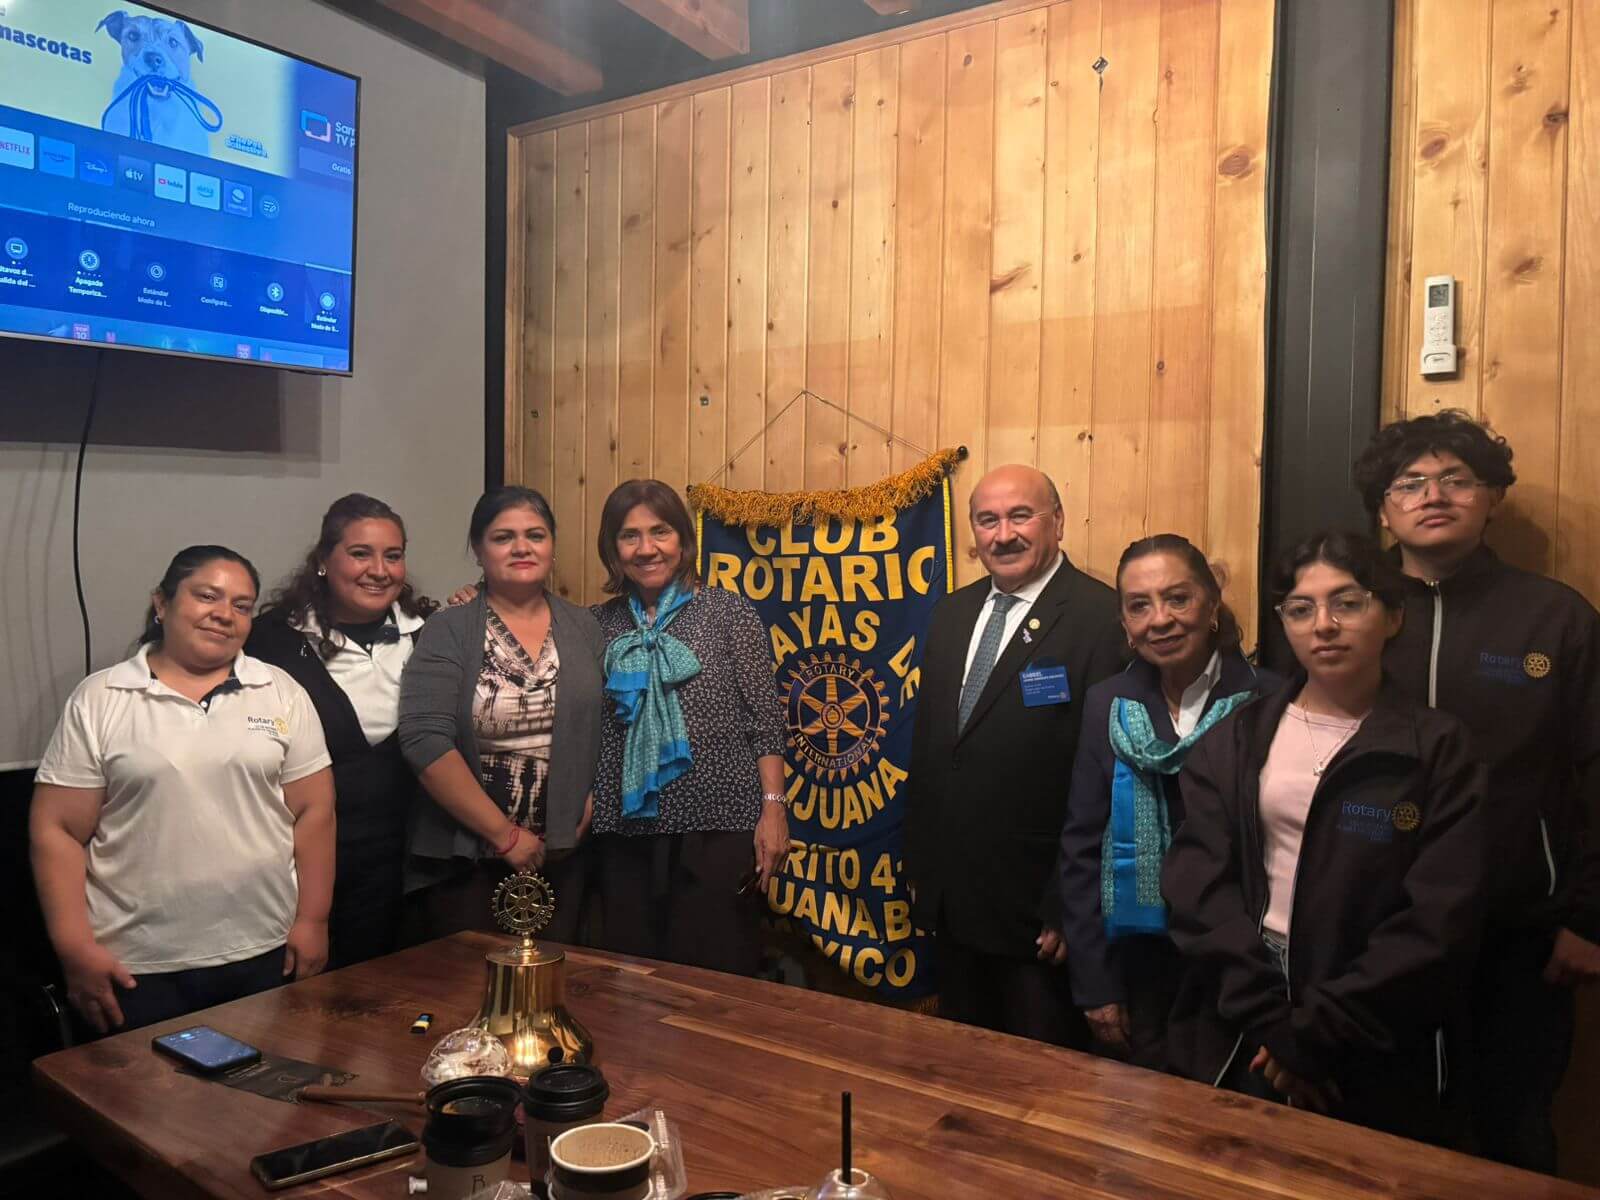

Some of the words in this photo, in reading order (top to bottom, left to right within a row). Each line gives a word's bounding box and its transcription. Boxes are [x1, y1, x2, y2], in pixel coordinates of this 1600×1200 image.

[336, 133, 348, 146] TV
[67, 202, 131, 222] Reproduciendo
[132, 217, 155, 228] ahora
[75, 277, 103, 287] Apagado
[746, 510, 899, 556] CLUB
[769, 604, 880, 672] AYAS
[804, 663, 856, 681] ROTARY
[248, 716, 274, 726] Rotary
[794, 730, 874, 769] INTERNATIONAL
[1342, 801, 1391, 822] Rotary
[784, 840, 861, 890] RITO
